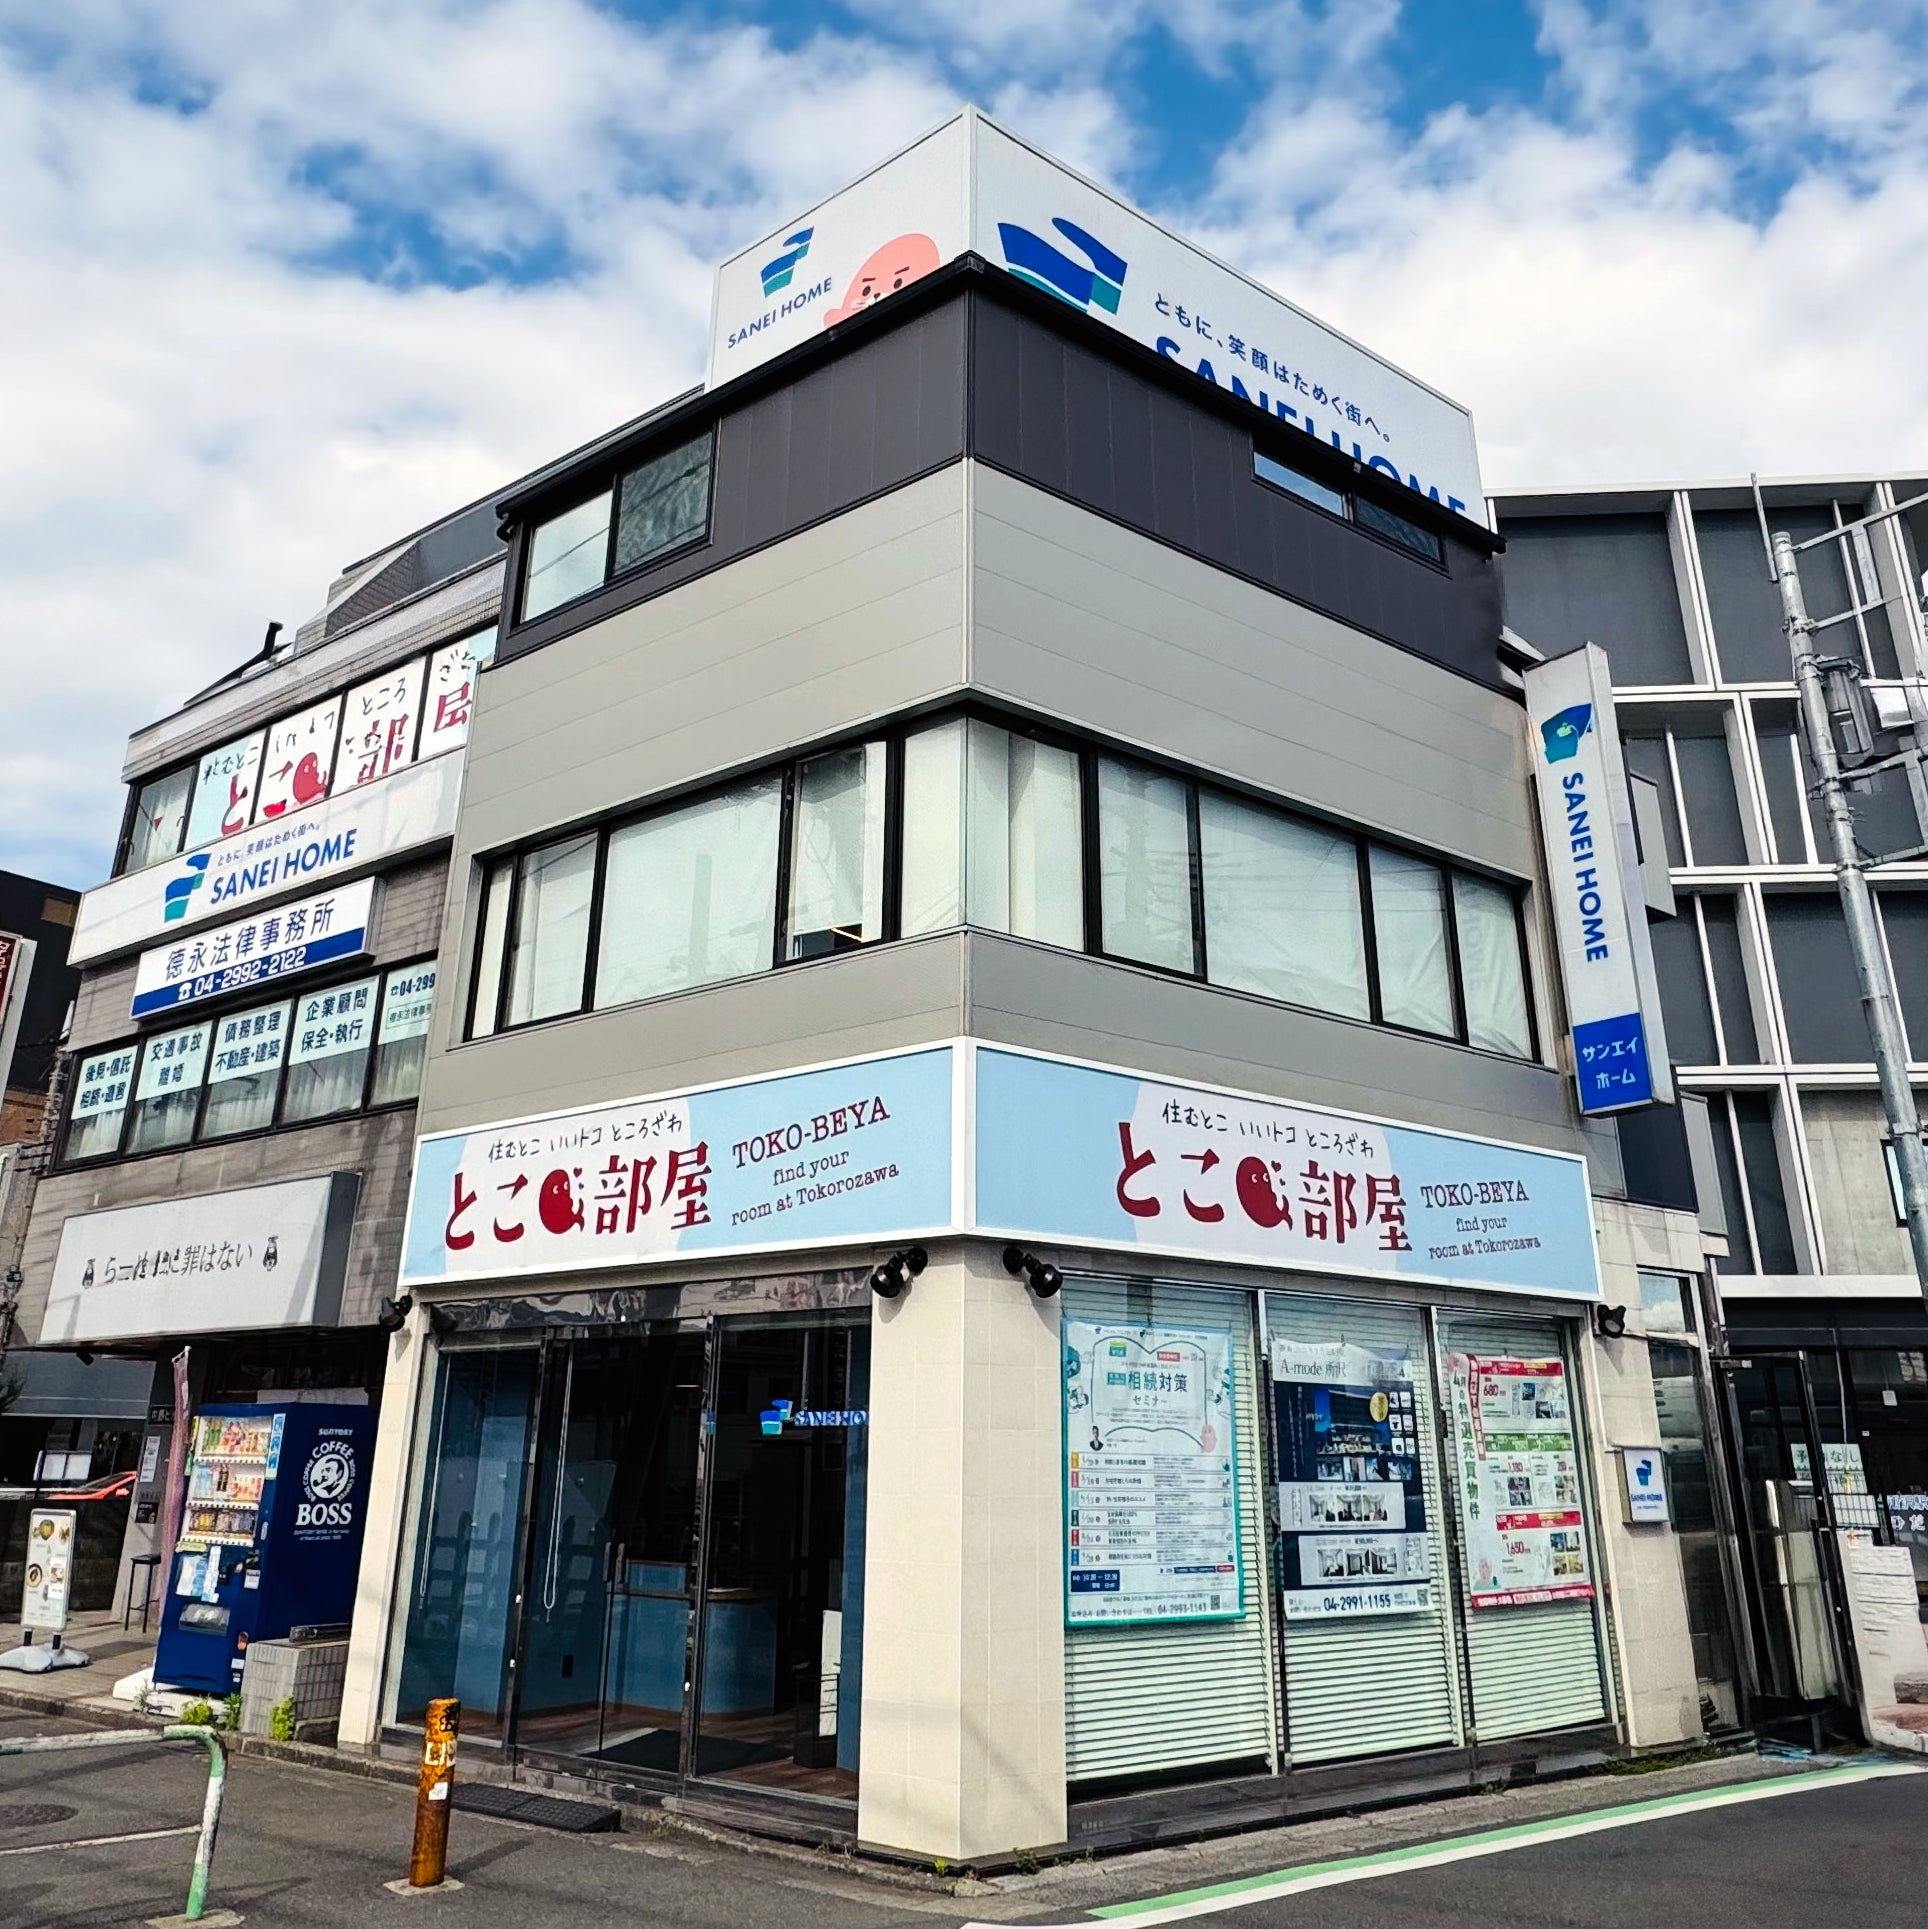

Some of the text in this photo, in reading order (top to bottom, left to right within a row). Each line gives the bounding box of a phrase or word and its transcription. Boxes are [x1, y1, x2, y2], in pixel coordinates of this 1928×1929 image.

[727, 276, 832, 350] SANEI HOME
[1154, 292, 1391, 443] ともに、笑顔はためく街へ。
[210, 828, 358, 905] SANEI HOME
[1562, 772, 1609, 963] SANEI HOME
[165, 898, 336, 981] 徳永法律事務所
[194, 946, 307, 997] 04-2992-2122
[305, 987, 368, 1022] 企業顧問
[224, 1010, 282, 1044] 債務整理
[150, 1031, 203, 1062] 交通事故
[1581, 1036, 1639, 1063] サンエイ
[1595, 1069, 1637, 1090] ホーム
[488, 1138, 541, 1164] 住むとこ
[611, 1109, 683, 1143] ところざわ
[731, 1095, 890, 1169] TOKO-BEYA
[1161, 1098, 1228, 1133] 住むとこ
[1305, 1128, 1374, 1159] ところざわ
[772, 1149, 850, 1187] find your
[730, 1162, 900, 1226] room at Tokorozawa
[1420, 1179, 1530, 1209] TOKO-BEYA
[1455, 1216, 1508, 1234] find your
[1428, 1237, 1542, 1260] room at Tokorozawa
[1128, 1371, 1188, 1393] 相続対策
[312, 1440, 355, 1459] COFFEE
[295, 1502, 353, 1526] BOSS
[1323, 1593, 1392, 1612] 04-2991-1155
